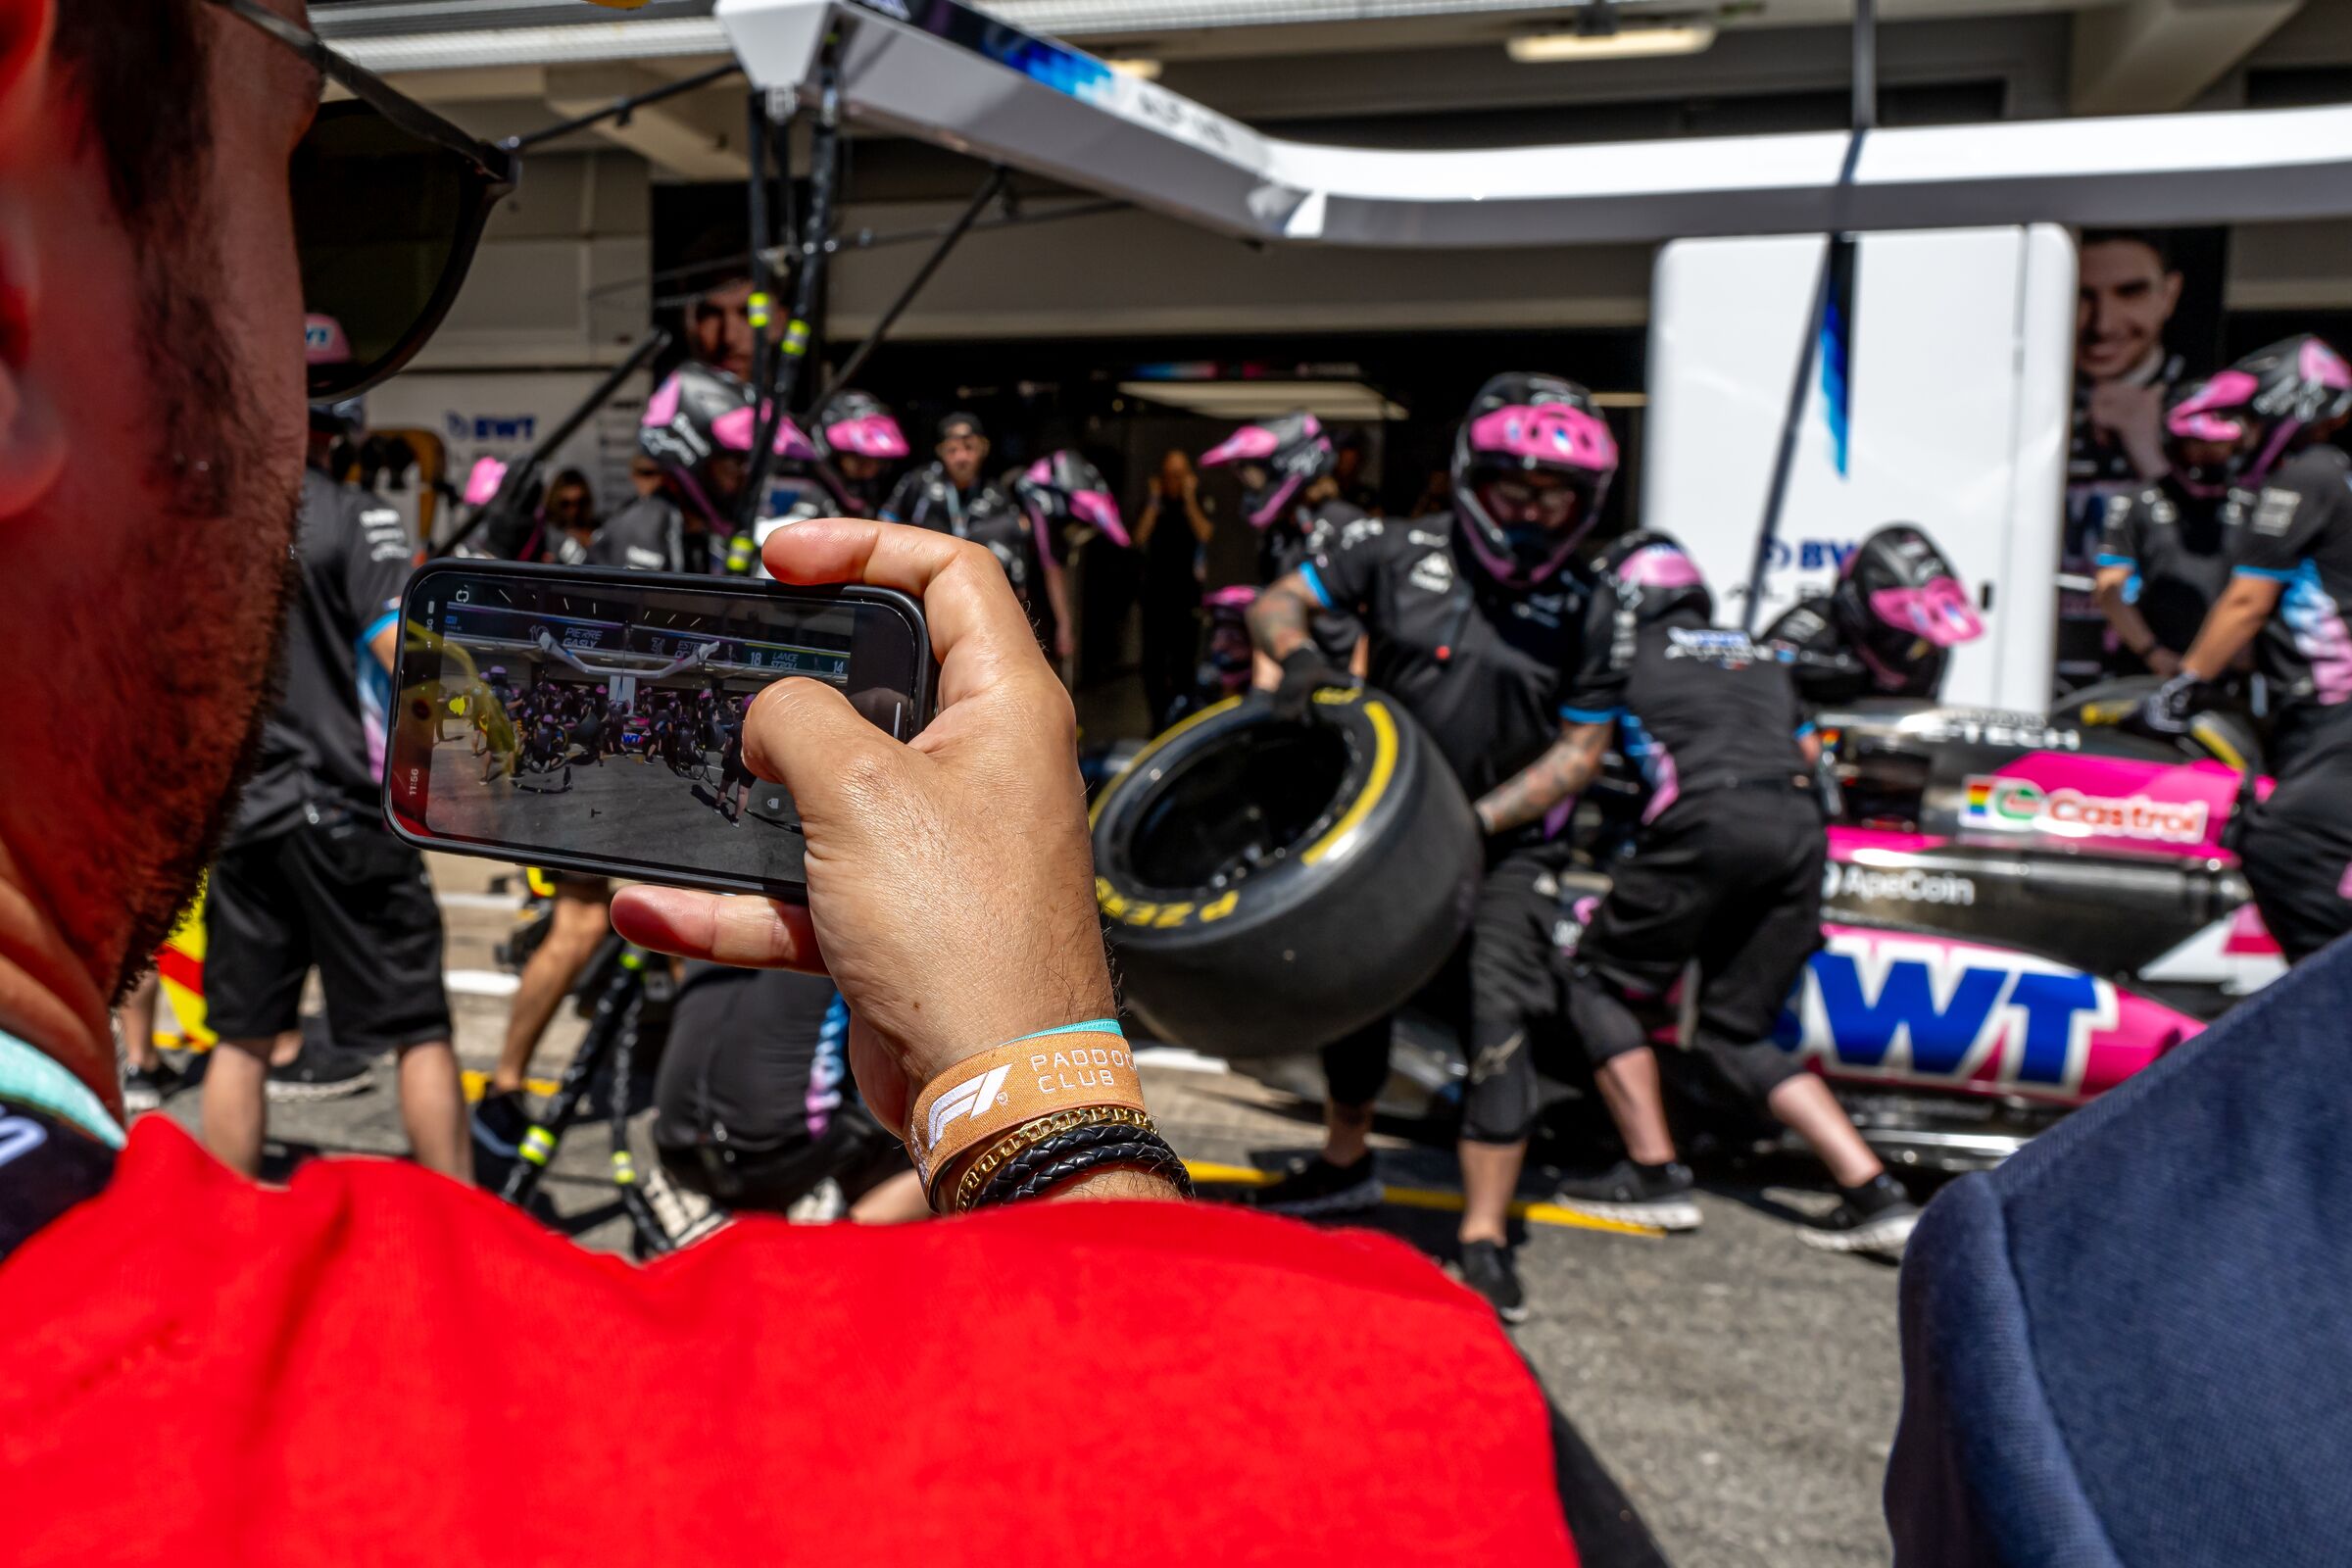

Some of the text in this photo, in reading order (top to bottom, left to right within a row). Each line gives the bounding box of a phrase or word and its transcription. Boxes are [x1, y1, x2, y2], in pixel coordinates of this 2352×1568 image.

[565, 627, 603, 640] PIERRE
[563, 638, 597, 648] GASLY
[751, 652, 762, 666] 18
[772, 652, 799, 662] LANCE
[834, 661, 844, 674] 14
[409, 768, 418, 796] 11:56
[2049, 798, 2199, 832] Castrol
[1840, 865, 1975, 906] ApeCoin
[1030, 1049, 1137, 1072] PADDOC
[1038, 1069, 1114, 1095] CLUB
